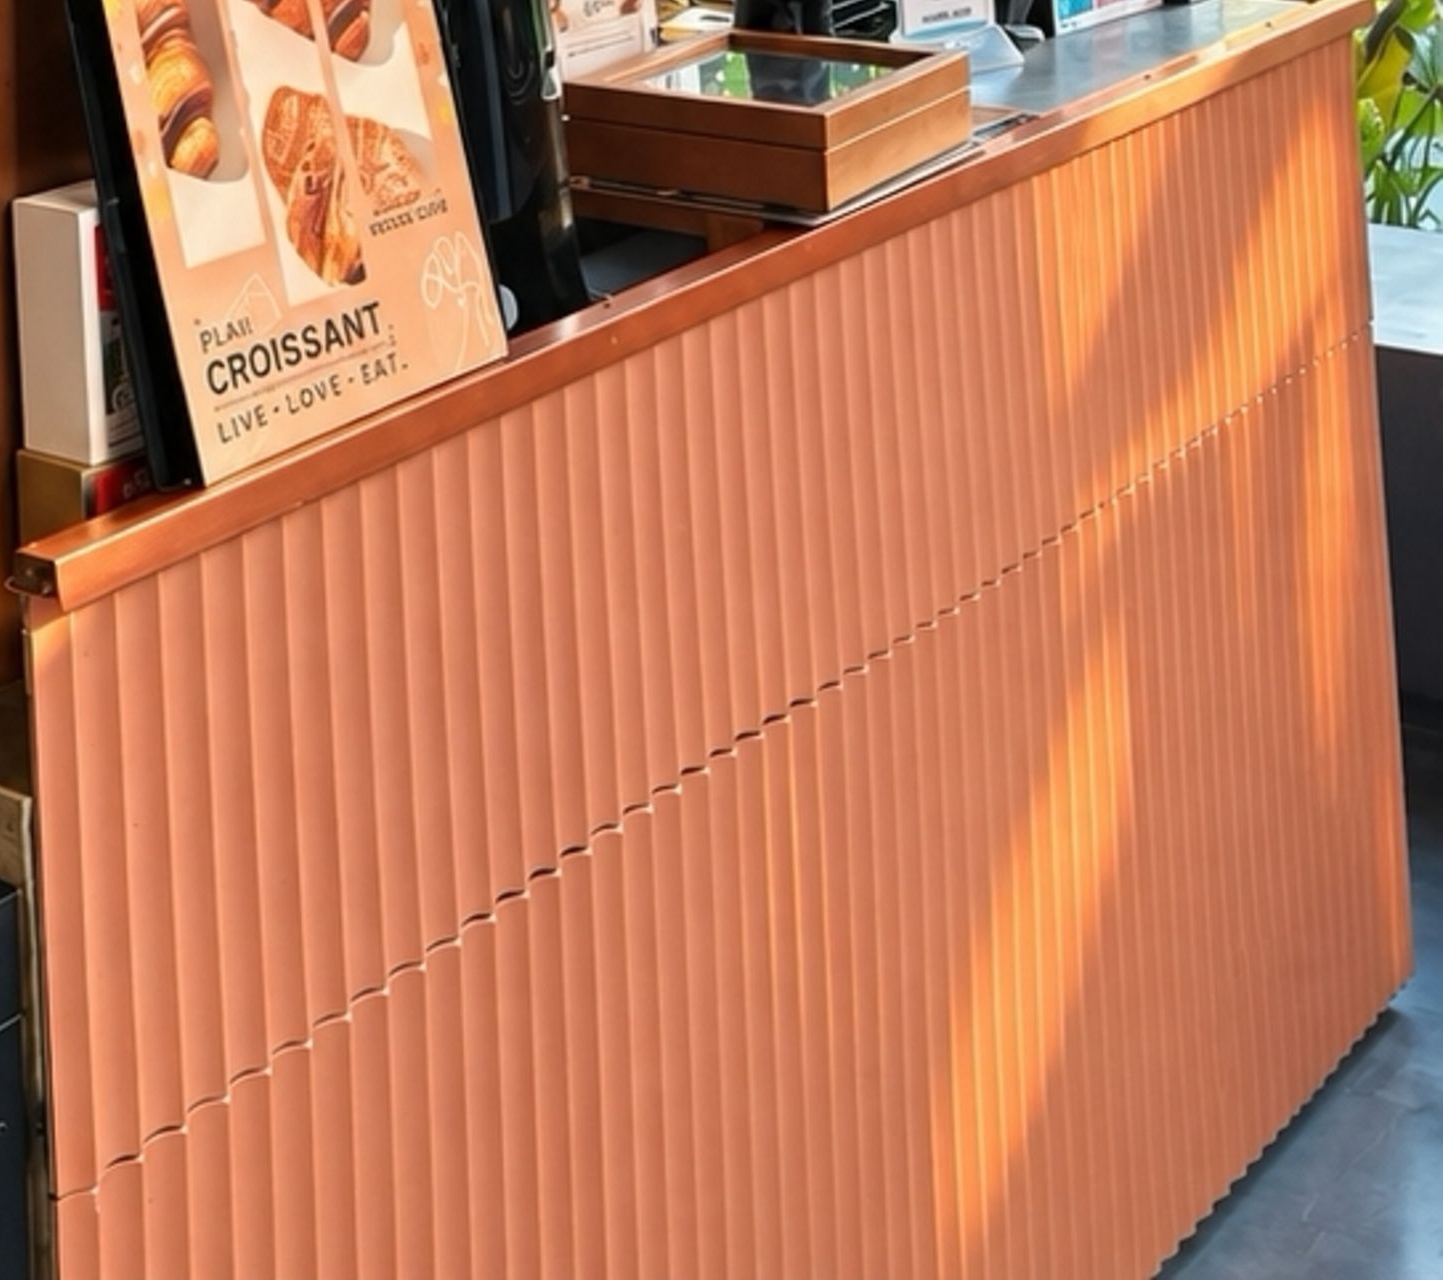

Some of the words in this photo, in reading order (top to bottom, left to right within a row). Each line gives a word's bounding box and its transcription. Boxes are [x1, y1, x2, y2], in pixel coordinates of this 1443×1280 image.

[206, 301, 380, 395] CROISSANT
[217, 404, 268, 444] LIVE
[285, 374, 342, 415] LOVE
